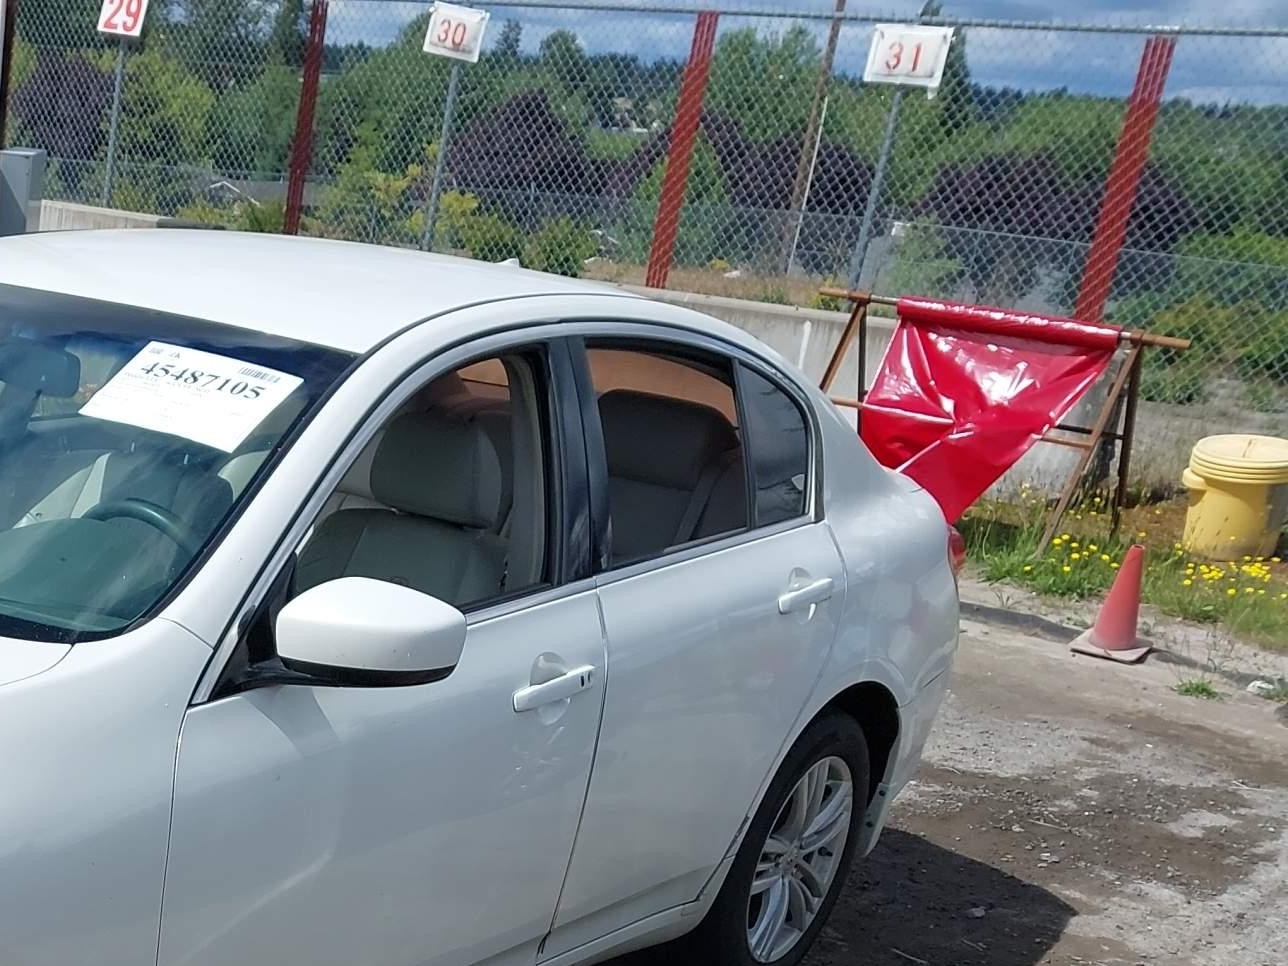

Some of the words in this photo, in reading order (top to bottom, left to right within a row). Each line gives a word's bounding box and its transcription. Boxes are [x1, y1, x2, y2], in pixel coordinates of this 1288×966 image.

[104, 0, 142, 32] 29
[437, 18, 467, 49] 30
[885, 41, 922, 73] 31
[140, 361, 267, 399] 45487105
